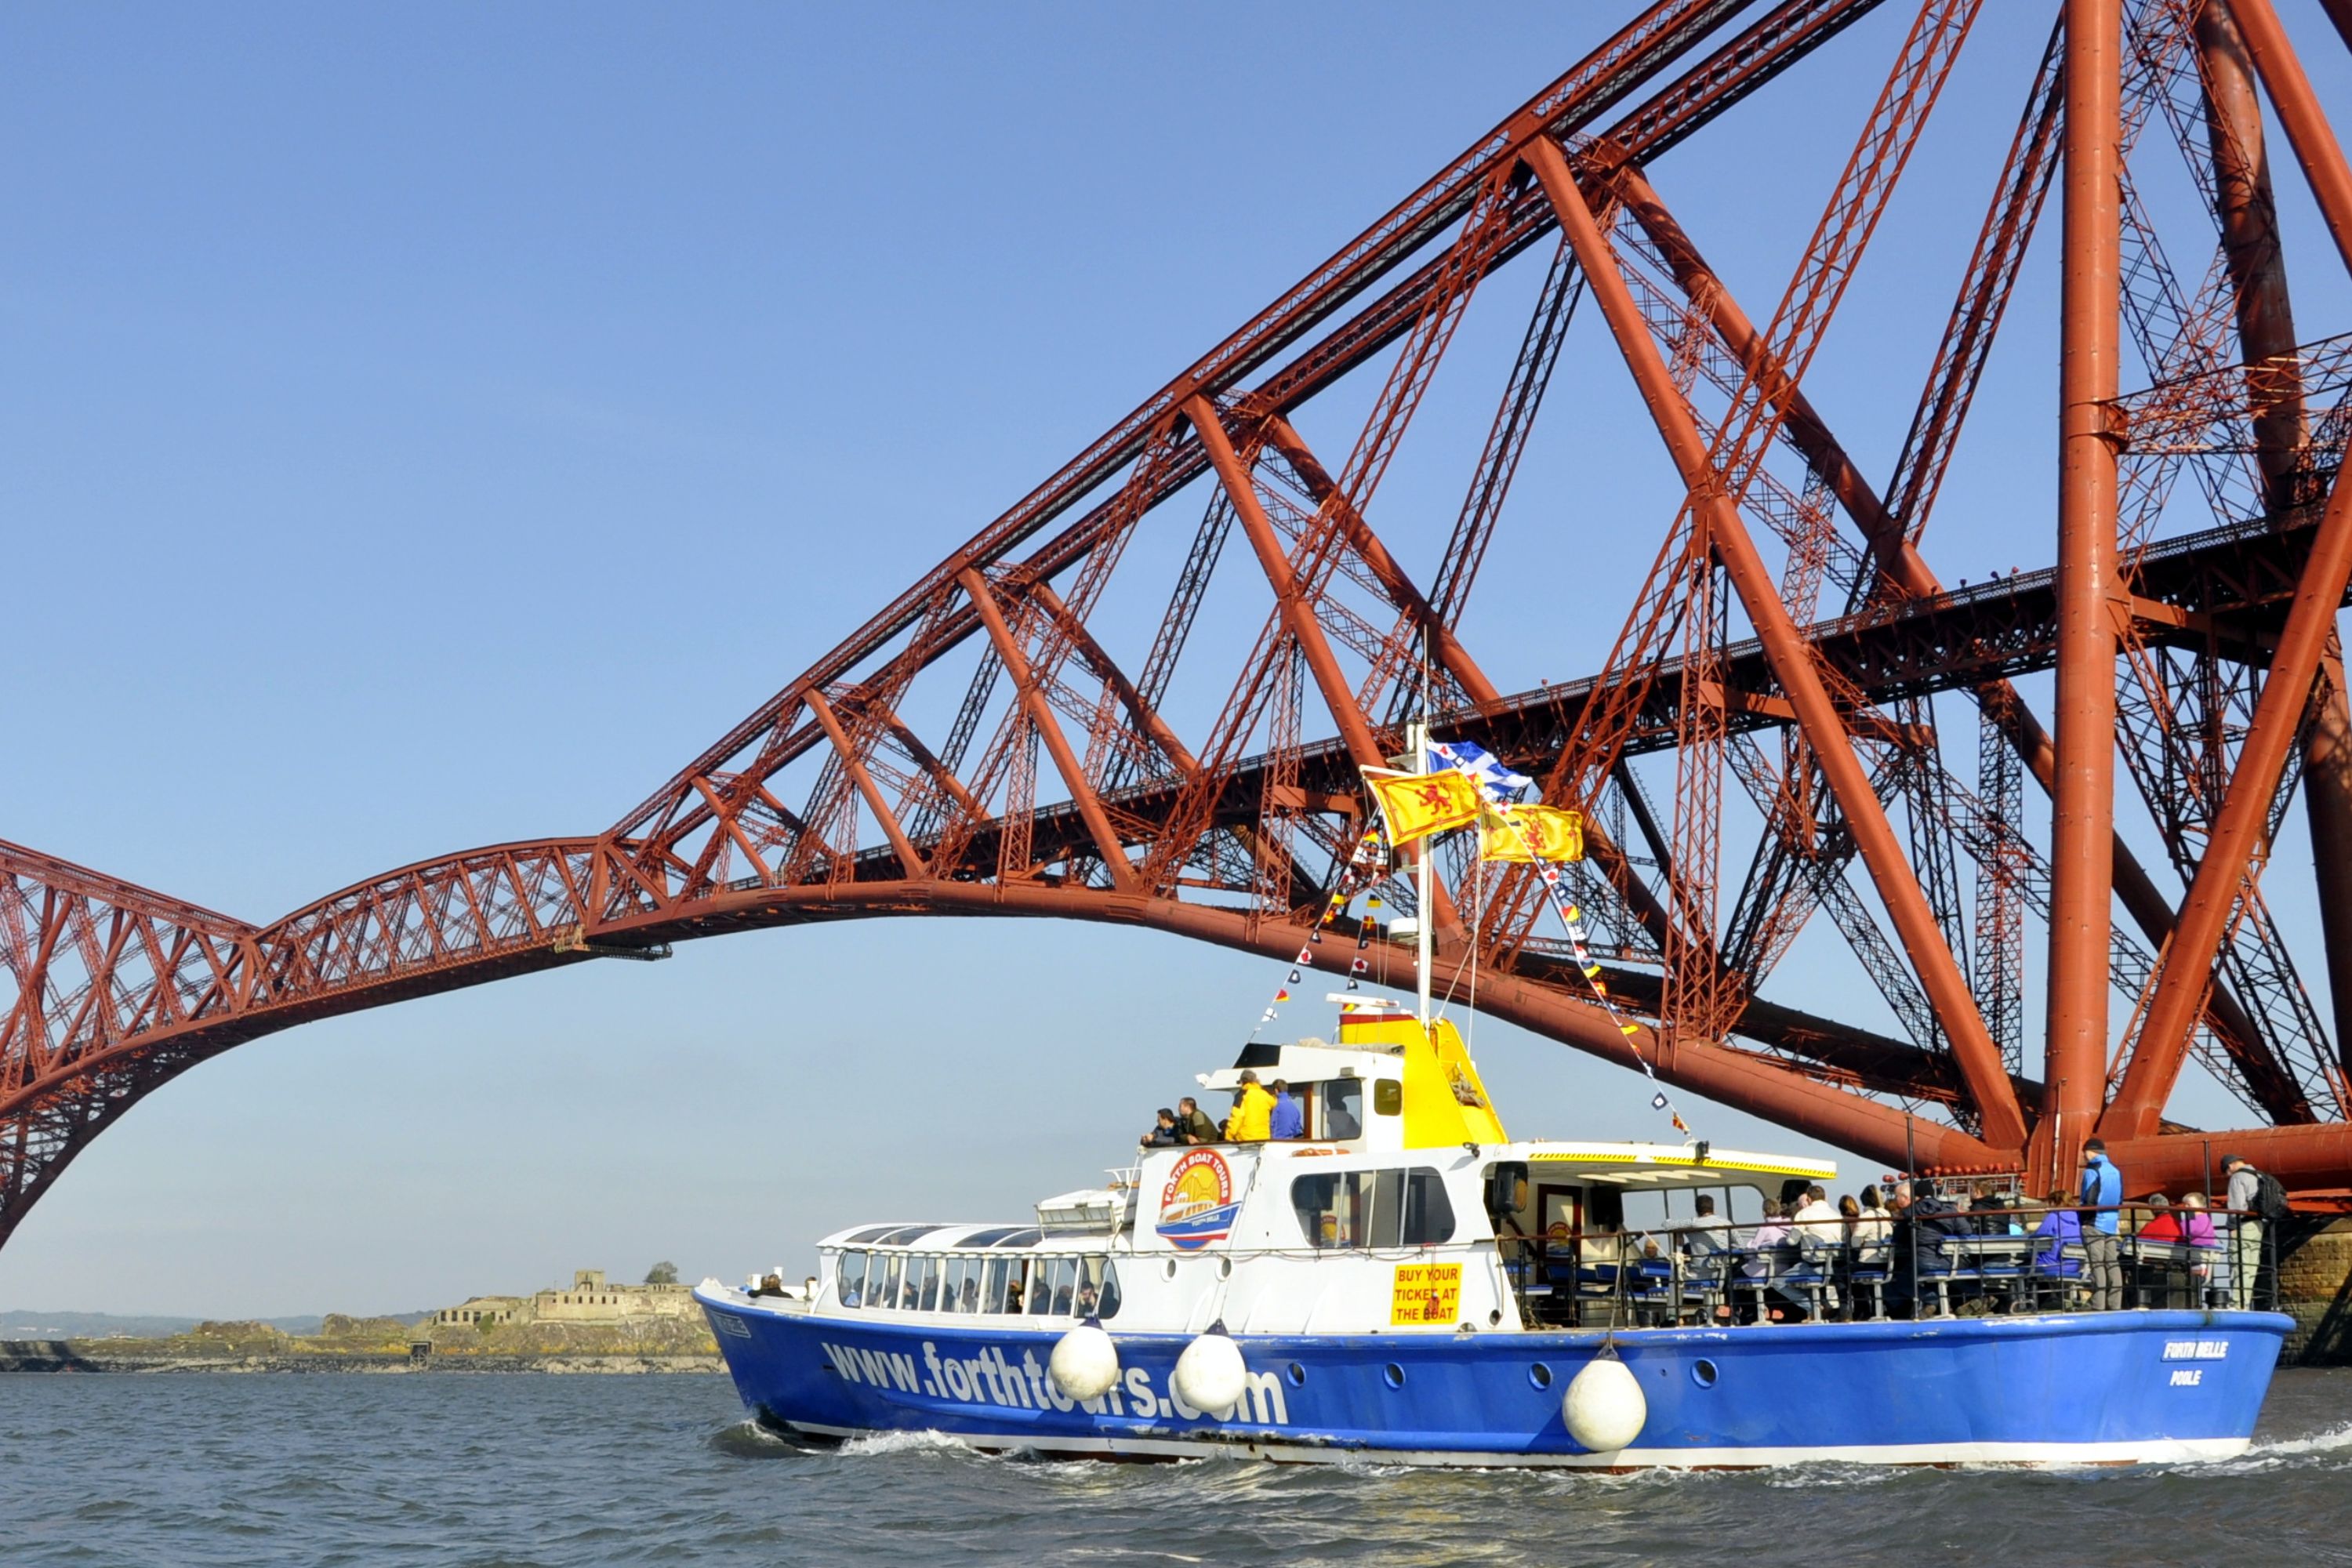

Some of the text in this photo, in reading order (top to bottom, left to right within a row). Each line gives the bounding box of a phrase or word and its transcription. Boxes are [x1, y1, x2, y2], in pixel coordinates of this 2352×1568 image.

[1165, 1153, 1229, 1201] FORTH BOAT TOURS
[1398, 1268, 1458, 1282] BUY YOUR
[1396, 1288, 1457, 1301] TICKET AT
[1396, 1307, 1454, 1321] THE BOAT
[2163, 1341, 2229, 1359] FORTH BELLE
[822, 1341, 1289, 1425] www.forthtors.cm
[2169, 1370, 2202, 1385] POOLE
